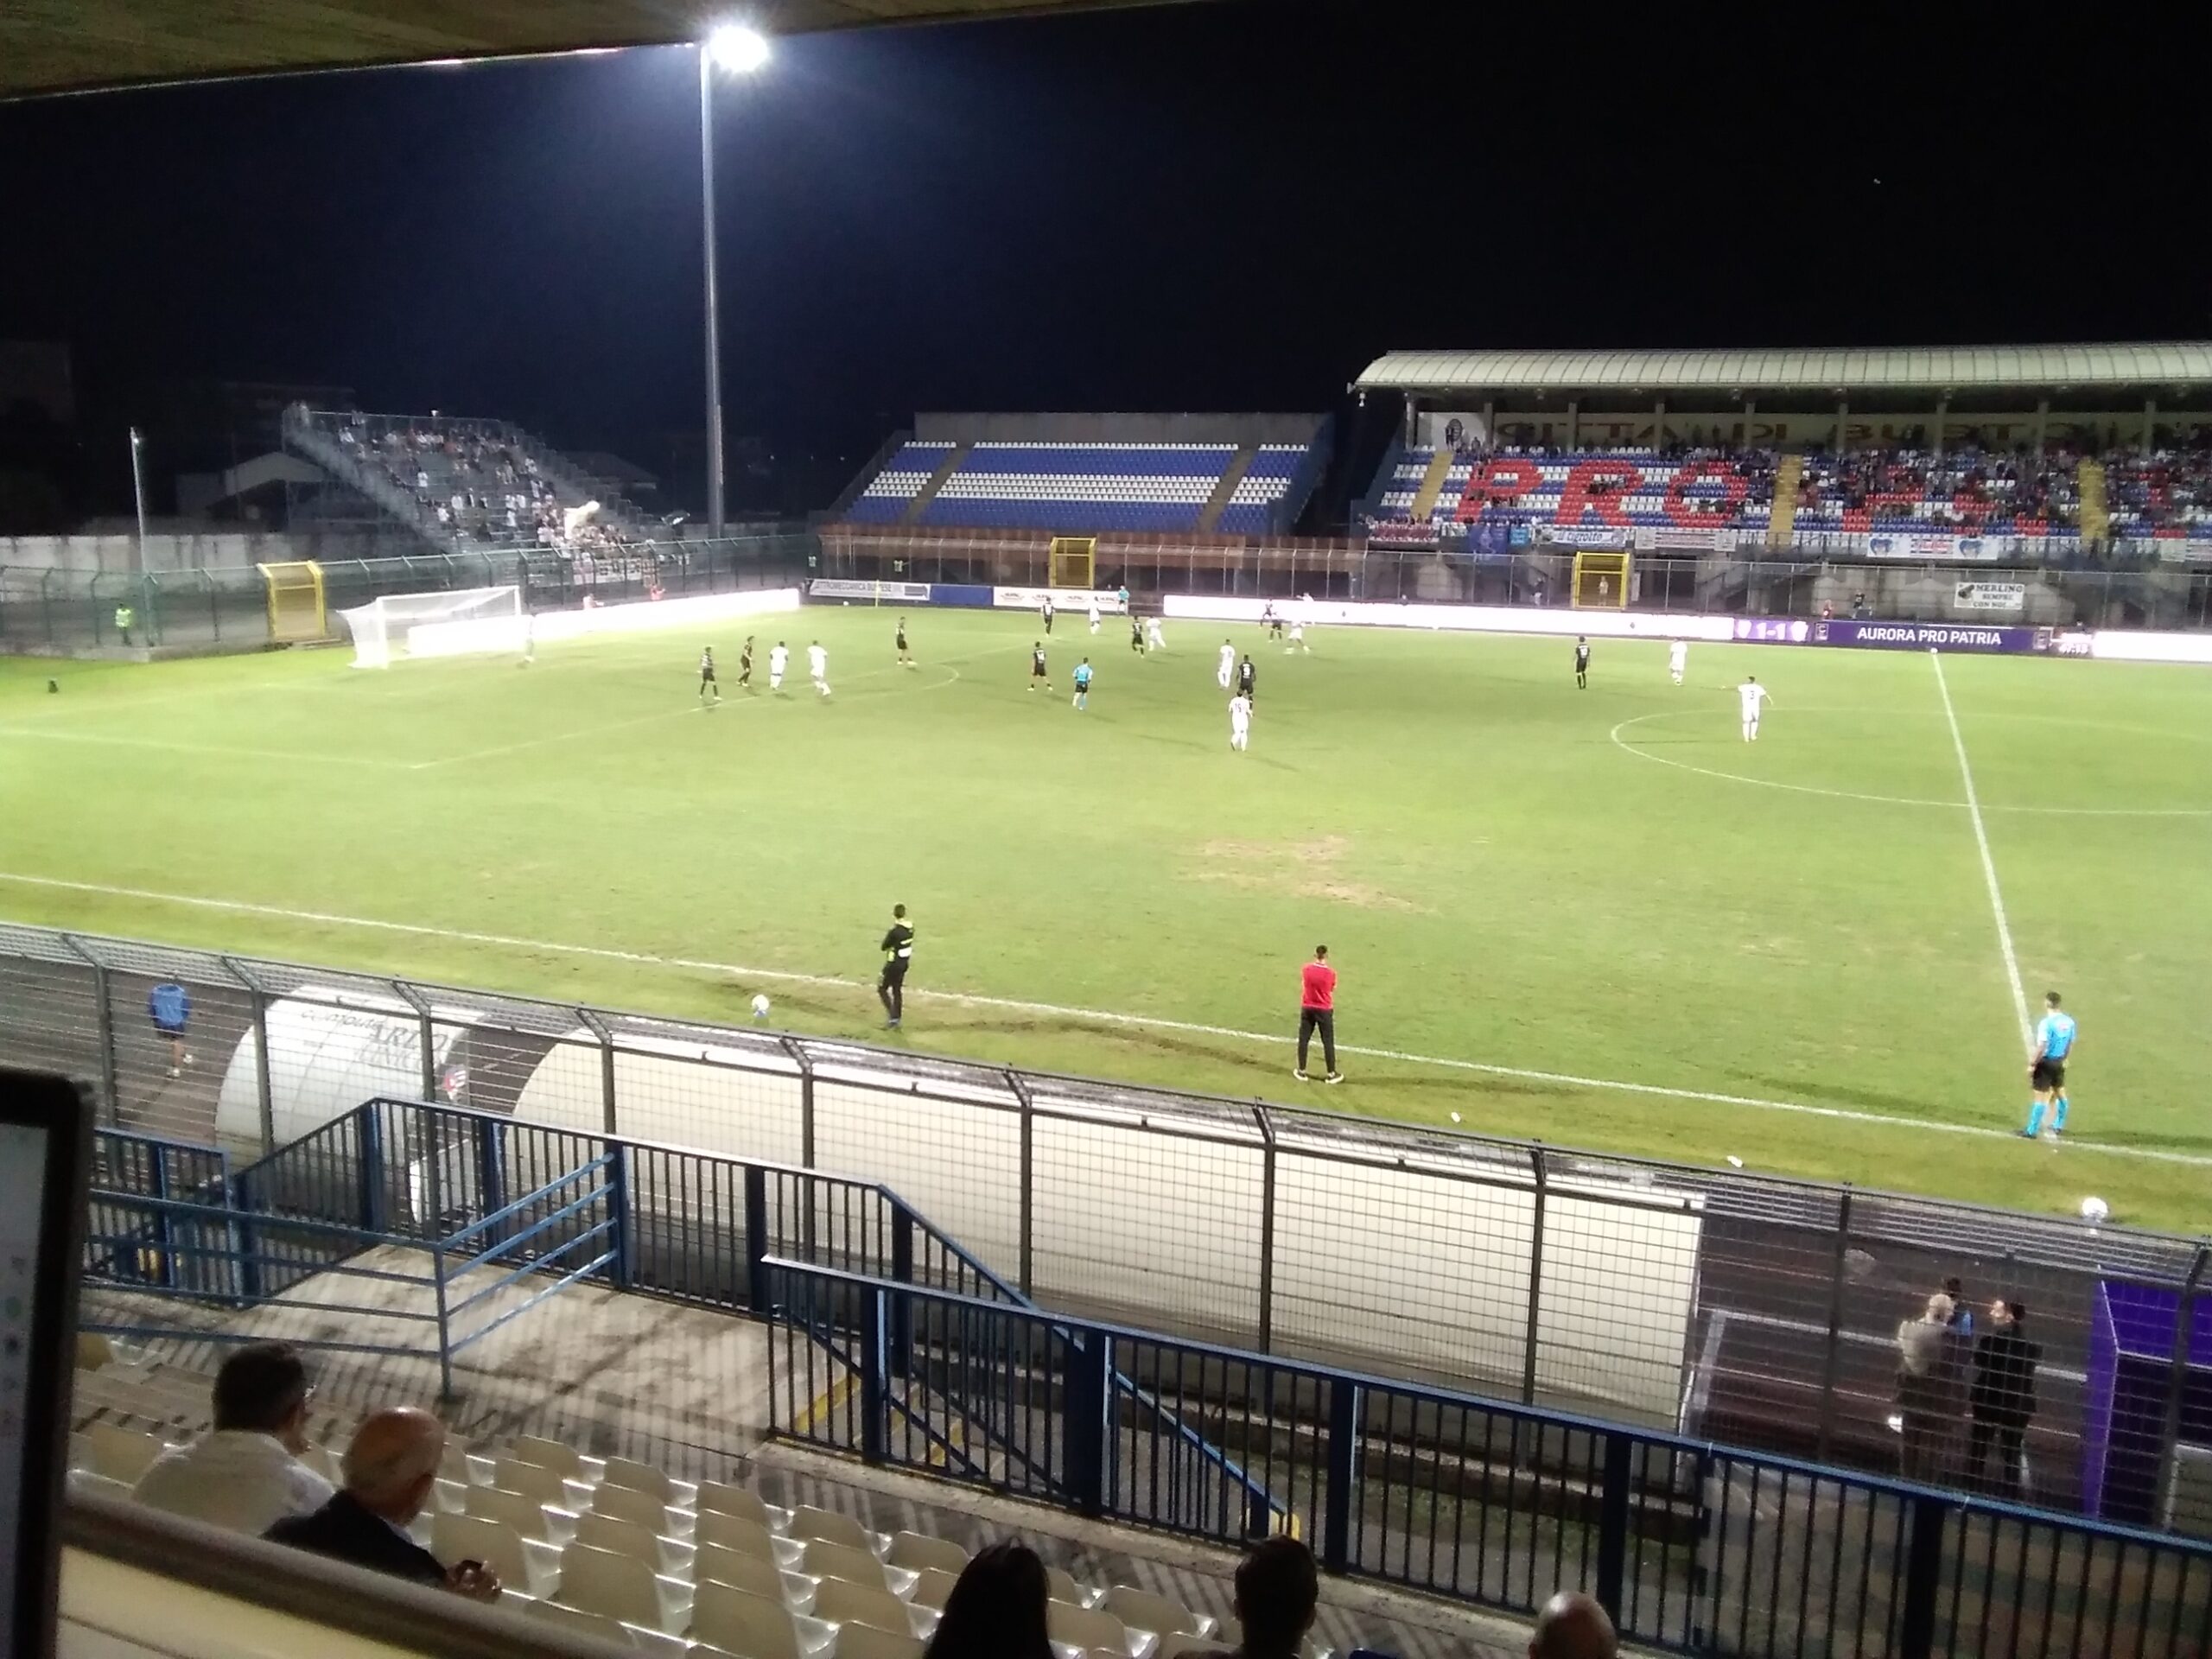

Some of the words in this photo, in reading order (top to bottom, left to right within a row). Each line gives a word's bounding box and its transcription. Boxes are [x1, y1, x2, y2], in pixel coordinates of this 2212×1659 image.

[1976, 584, 2024, 593] MERLINO
[1857, 626, 1916, 641] AURORA
[1918, 629, 1948, 643] PRO
[1949, 631, 2003, 645] PATRIA
